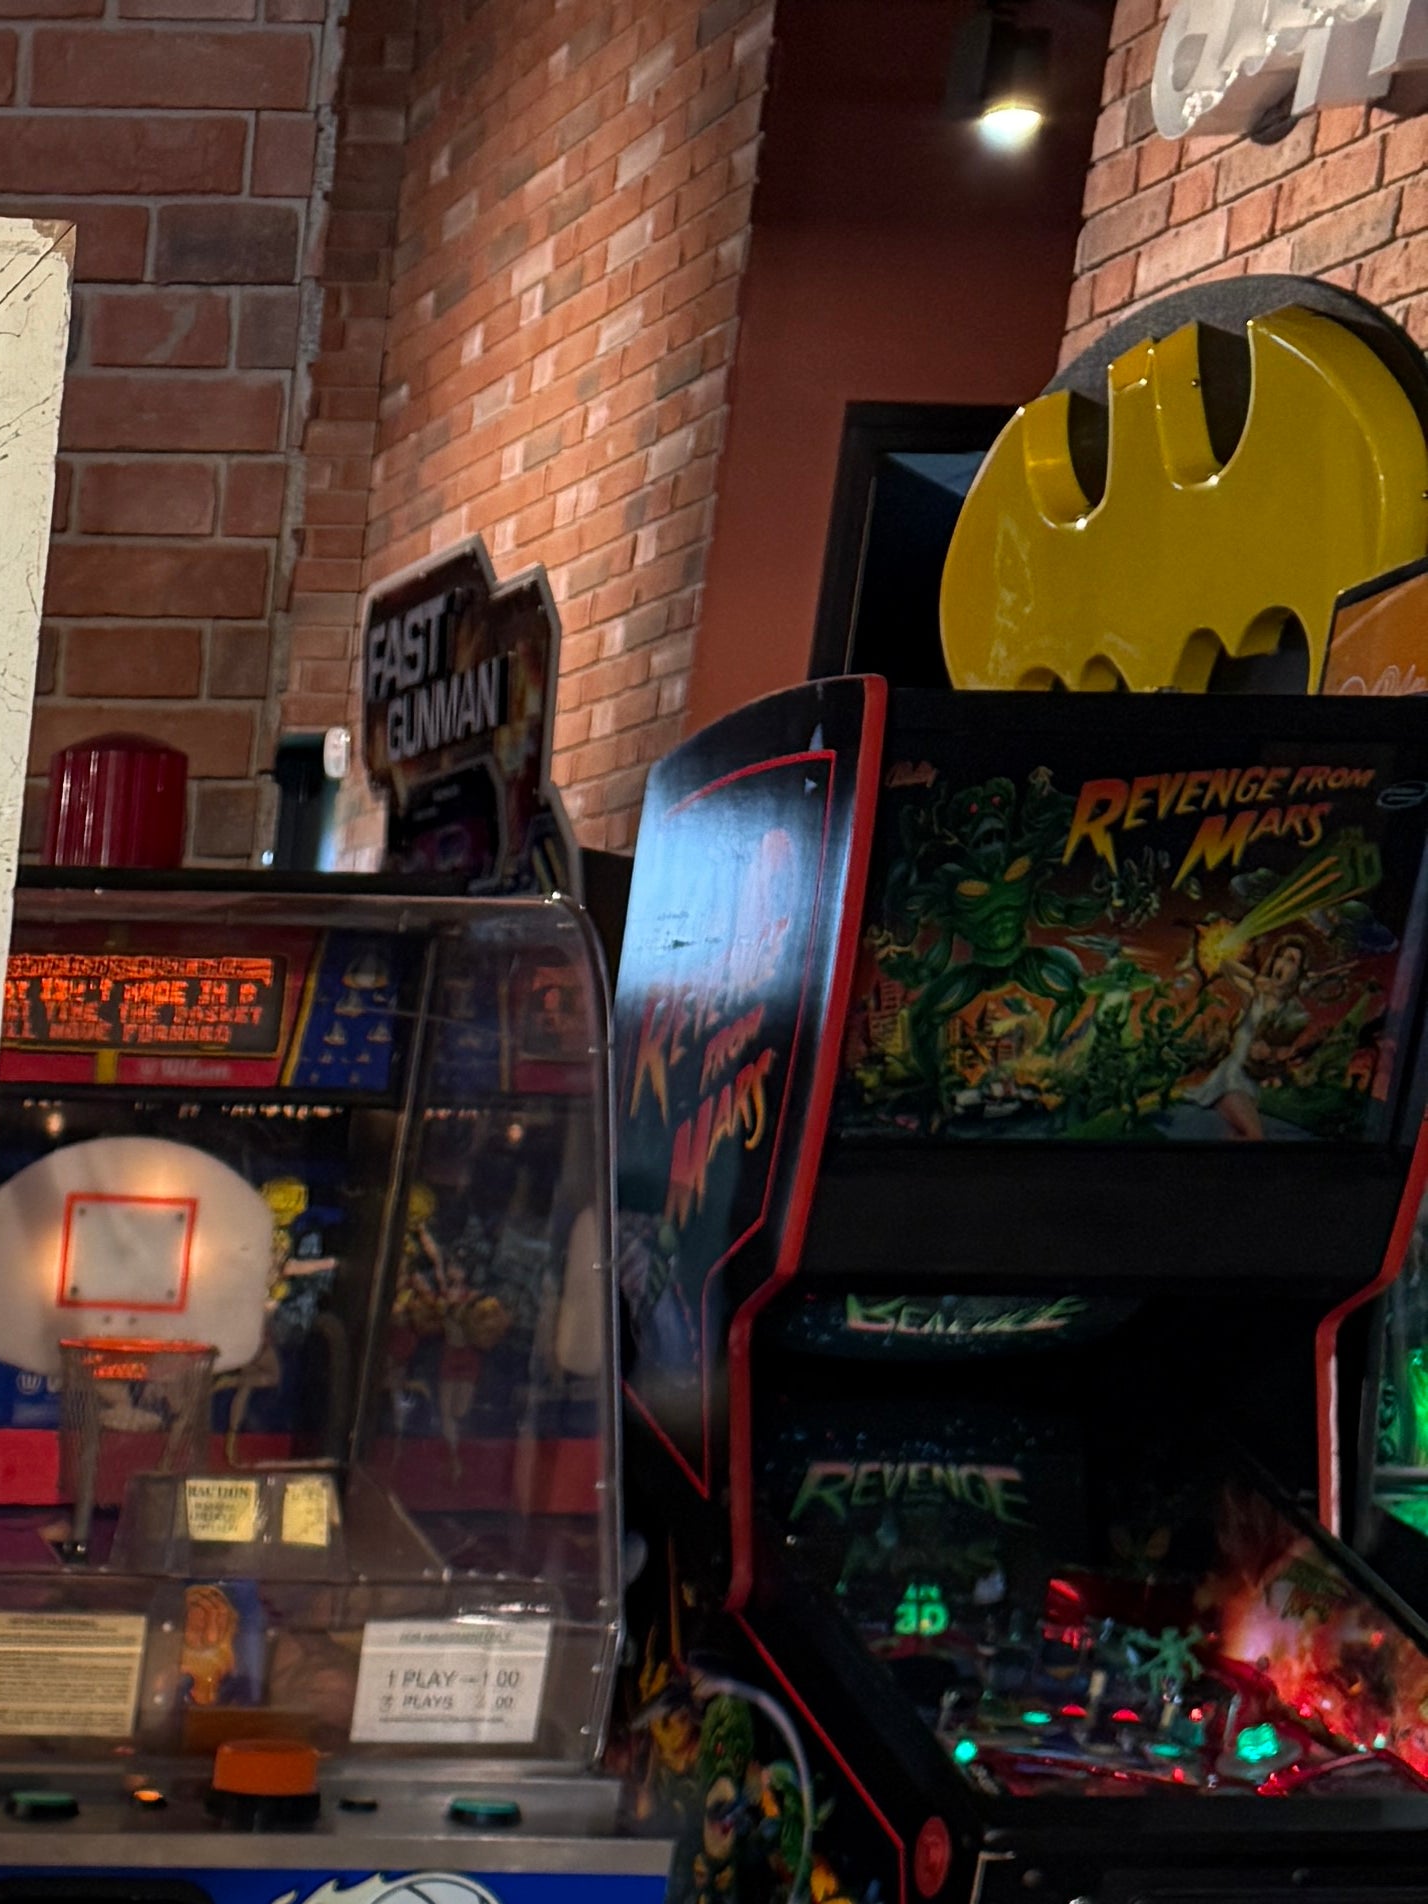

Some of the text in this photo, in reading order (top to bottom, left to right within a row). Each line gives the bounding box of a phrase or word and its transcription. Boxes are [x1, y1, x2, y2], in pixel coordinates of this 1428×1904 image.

[368, 596, 448, 701] FAST
[387, 656, 502, 762] GUNMAN
[1062, 765, 1376, 878] REVENGE FROM
[1171, 802, 1332, 890] MARS
[789, 1461, 1036, 1530] REVENGE
